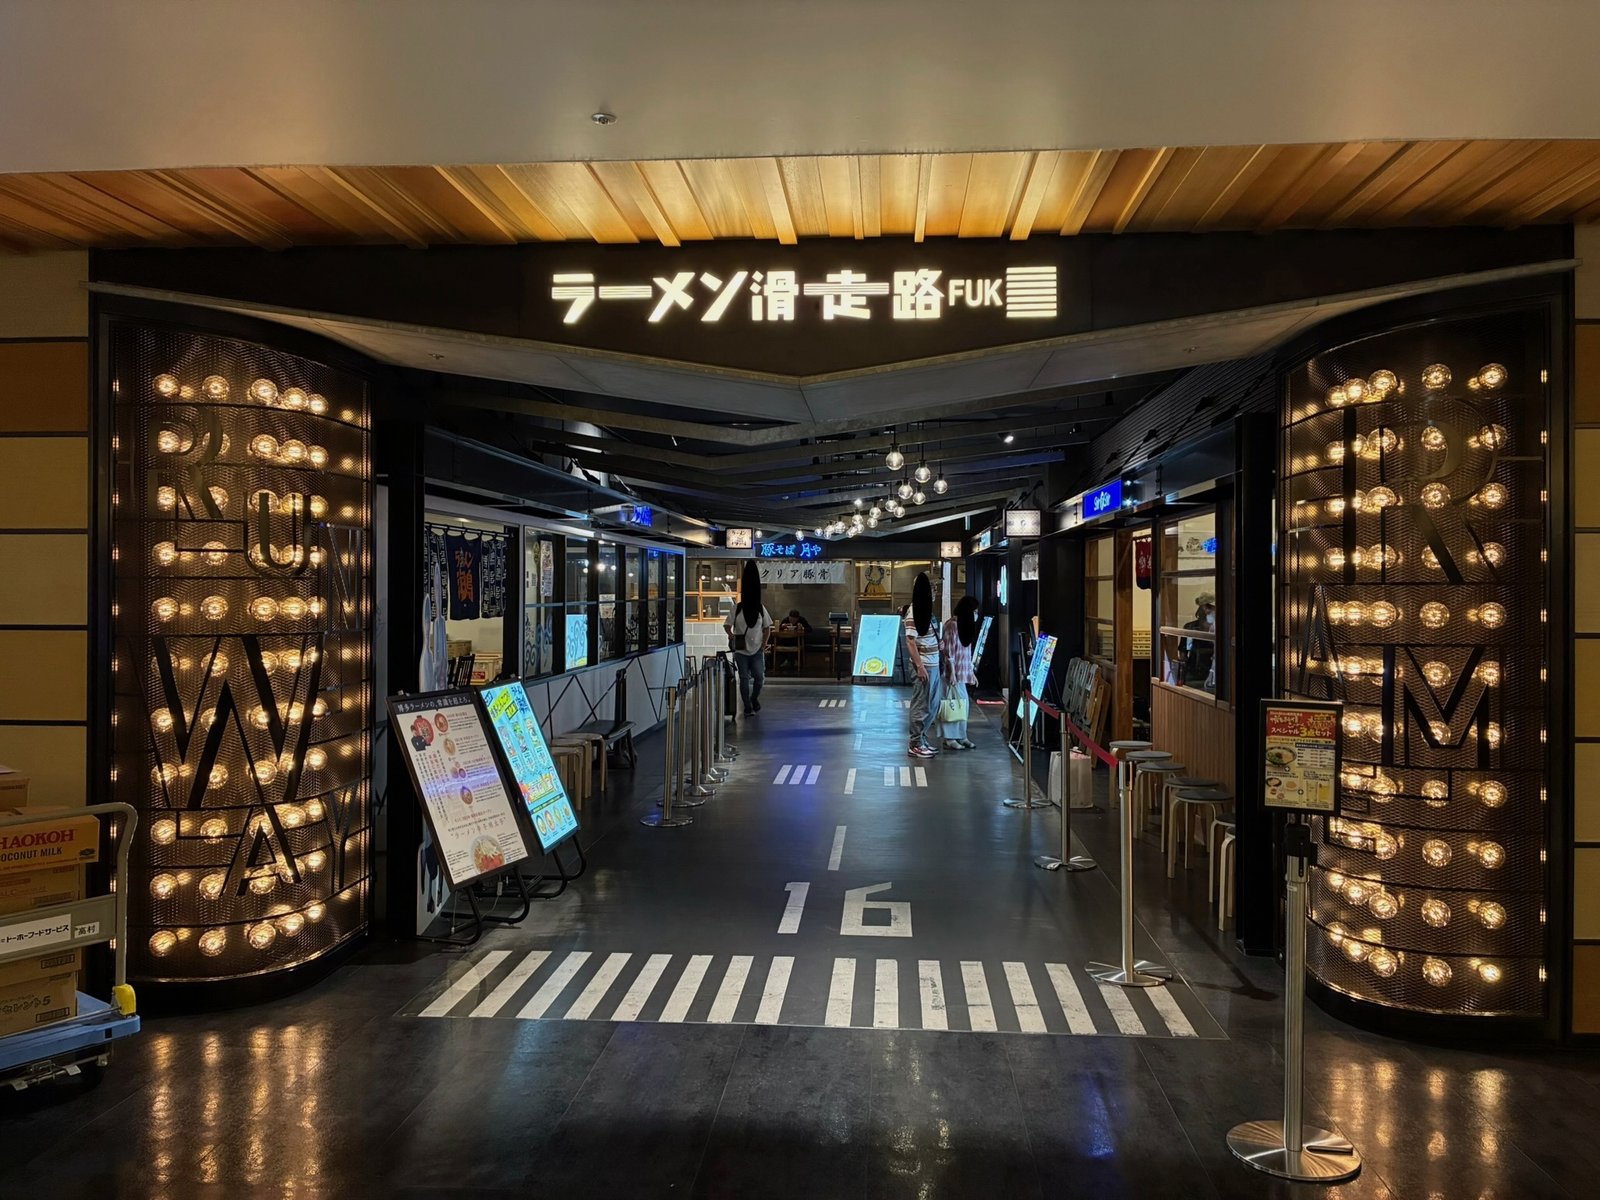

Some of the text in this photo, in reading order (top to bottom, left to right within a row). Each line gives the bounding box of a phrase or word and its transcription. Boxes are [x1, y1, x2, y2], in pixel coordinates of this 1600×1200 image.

[552, 269, 1003, 322] ラーメン滑走路 FUK
[760, 543, 796, 557] 豚そば
[800, 543, 822, 557] 月や
[761, 568, 830, 580] クリア豚骨
[0, 847, 63, 862] OCONUT MILK
[777, 881, 913, 937] 16
